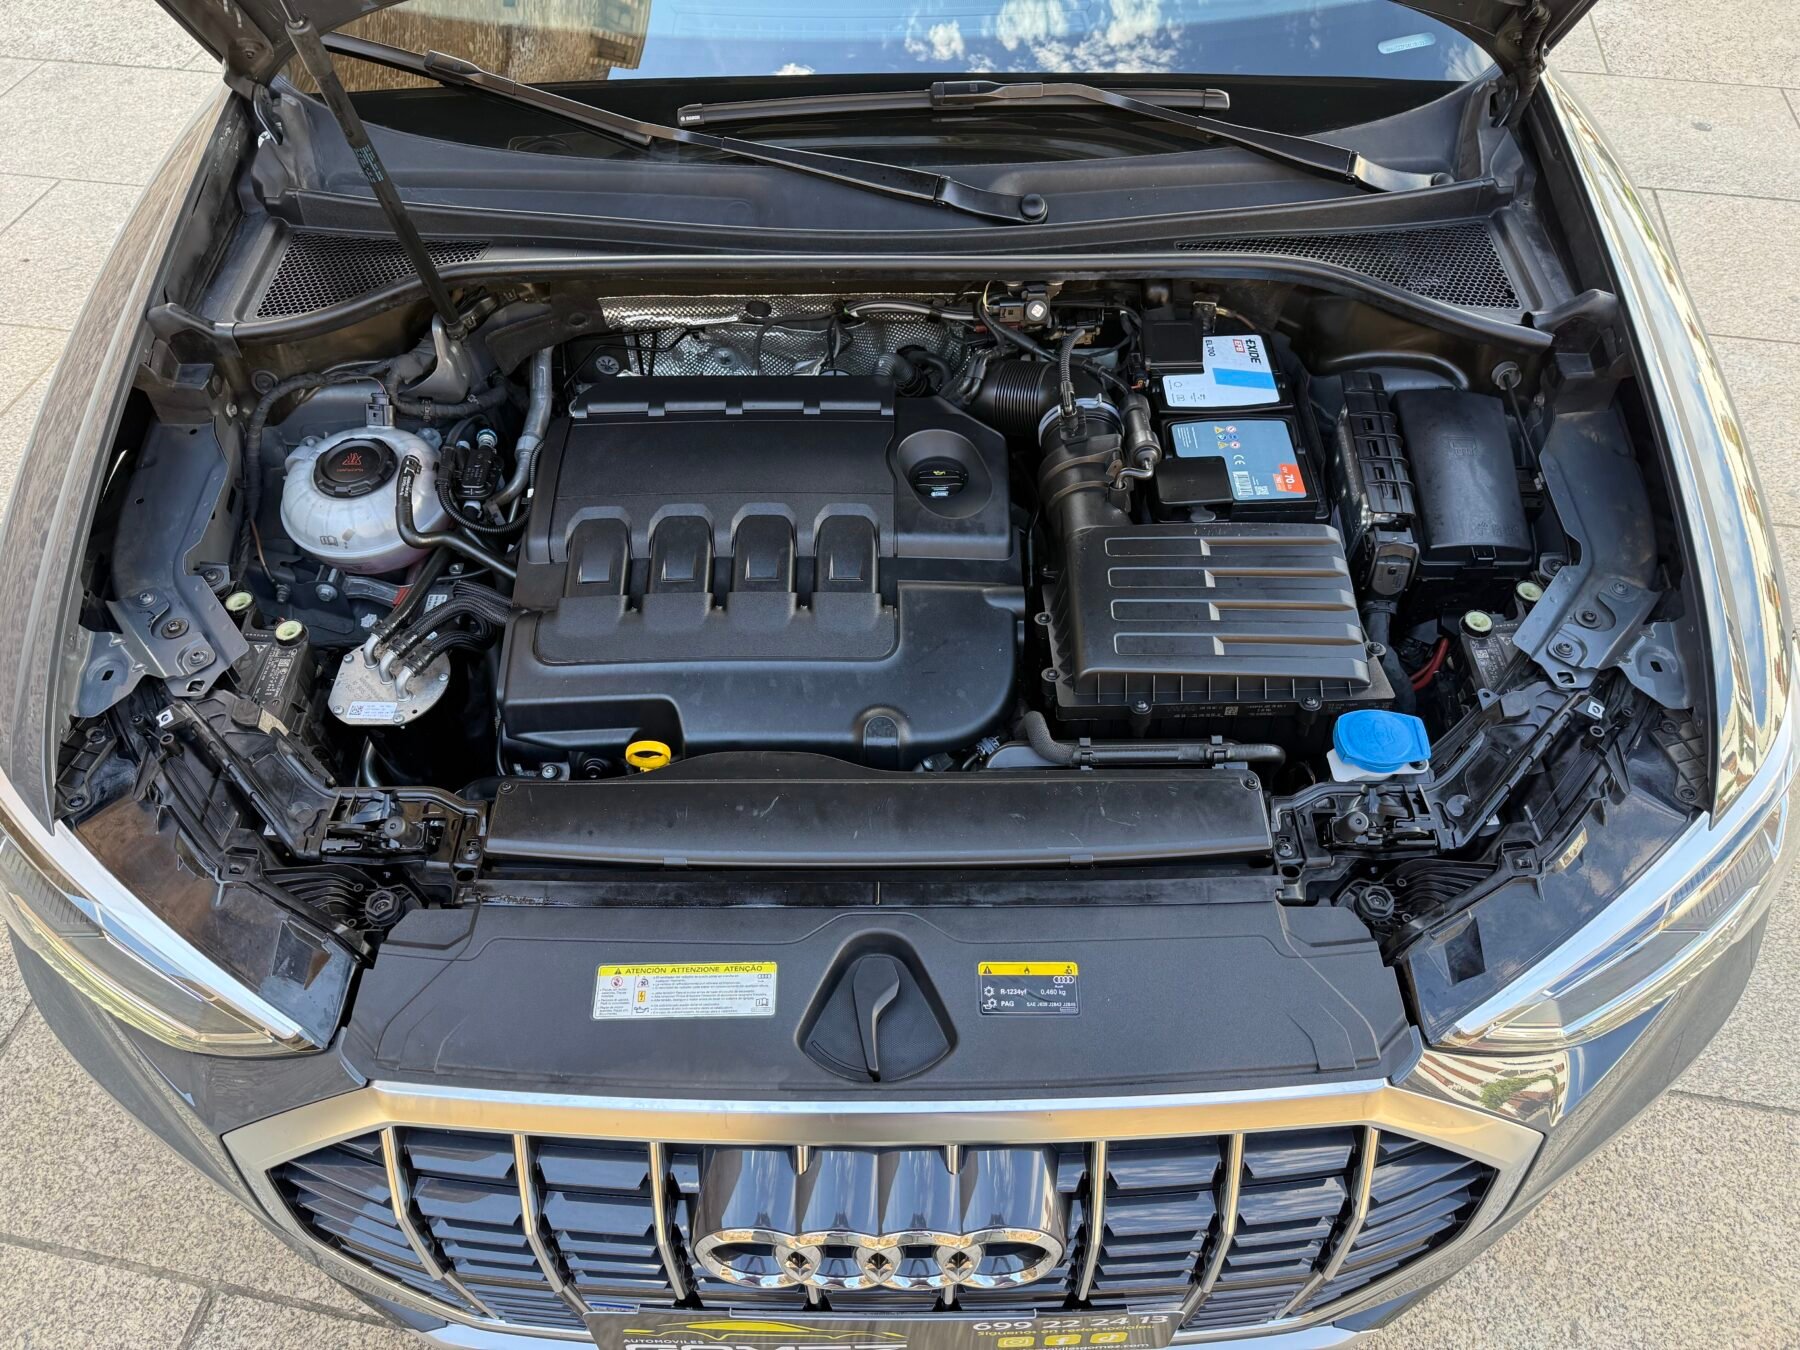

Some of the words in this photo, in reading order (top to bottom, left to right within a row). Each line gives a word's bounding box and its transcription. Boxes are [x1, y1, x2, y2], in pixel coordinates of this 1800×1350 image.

[1245, 339, 1262, 365] EXIDE
[1284, 473, 1295, 484] 70
[625, 966, 667, 974] ATENCIÓN
[670, 966, 720, 974] ATTENZIONE
[724, 964, 763, 973] ATENÇÃO
[1000, 988, 1027, 996] R-1234yf
[972, 1321, 1033, 1331] 699
[1042, 1319, 1081, 1329] 22
[1090, 1317, 1129, 1327] 24
[1139, 1315, 1169, 1324] 13
